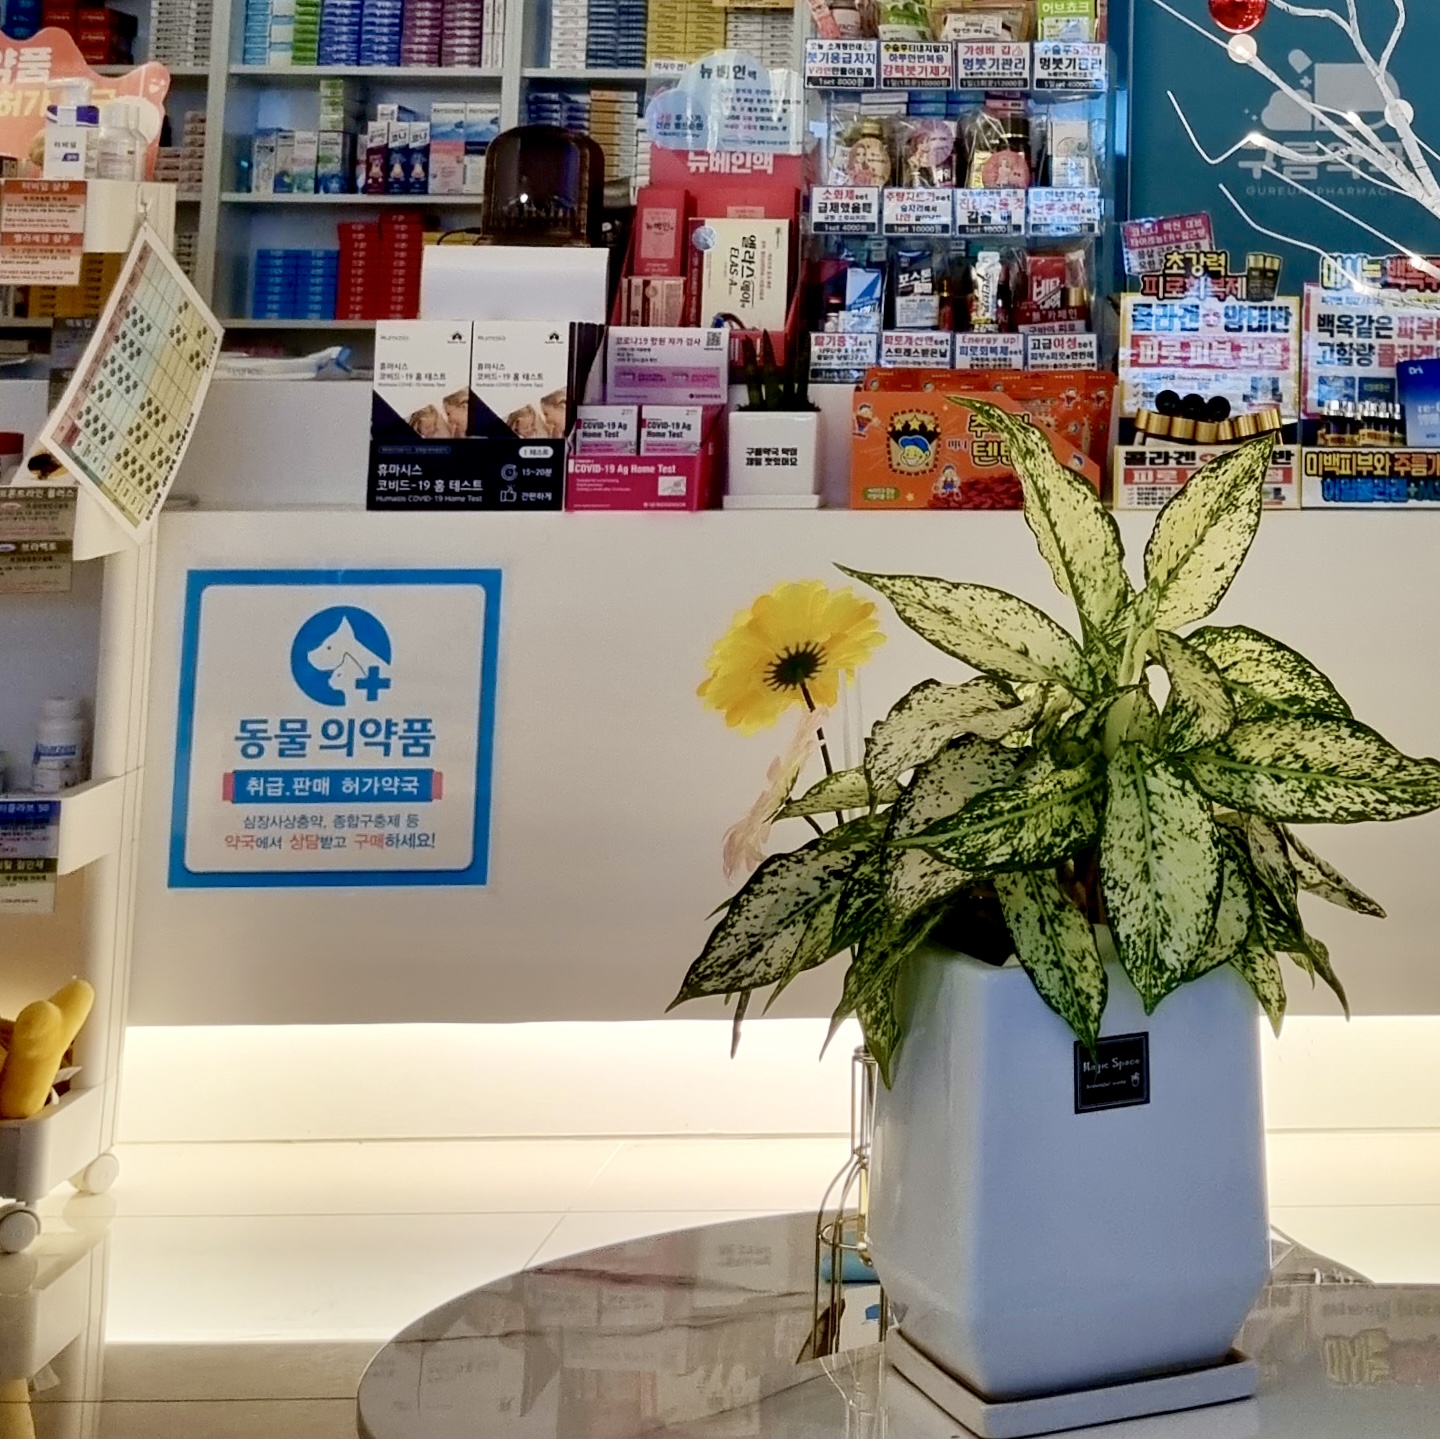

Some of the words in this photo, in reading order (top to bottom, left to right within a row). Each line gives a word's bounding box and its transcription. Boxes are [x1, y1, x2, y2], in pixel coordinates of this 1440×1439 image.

[687, 150, 774, 174] 뉴베인액
[1317, 187, 1399, 197] PHARMAC
[1165, 252, 1227, 276] 초강력
[1317, 313, 1393, 339] 백옥같은
[1316, 341, 1376, 367] 고함량
[582, 421, 616, 430] COVID-19
[646, 421, 680, 430] COVID-19
[582, 430, 602, 438] Home
[604, 430, 620, 438] Test
[646, 430, 667, 438] Home
[668, 430, 684, 438] Test
[377, 463, 423, 477] 휴마시스
[574, 464, 615, 474] COVID-19
[616, 464, 629, 476] Ag
[630, 463, 656, 474] Home
[657, 463, 676, 474] Test
[1305, 451, 1391, 476] 미백피부와
[375, 479, 431, 493] 코비드-19
[433, 479, 446, 493] 홈
[448, 479, 484, 493] 테스트
[467, 494, 483, 503] Test
[521, 491, 553, 503] 간편하게
[234, 718, 312, 759] 동물
[319, 717, 436, 758] 의약품
[341, 774, 420, 795] 허가약국
[243, 813, 327, 829] 심장사상충약,
[332, 813, 401, 829] 종합구충제
[405, 813, 420, 828] 등
[224, 834, 283, 850] 약국에서
[289, 833, 347, 849] 상담받고
[353, 832, 436, 850] 구매하세요!
[1111, 1056, 1140, 1071] Space
